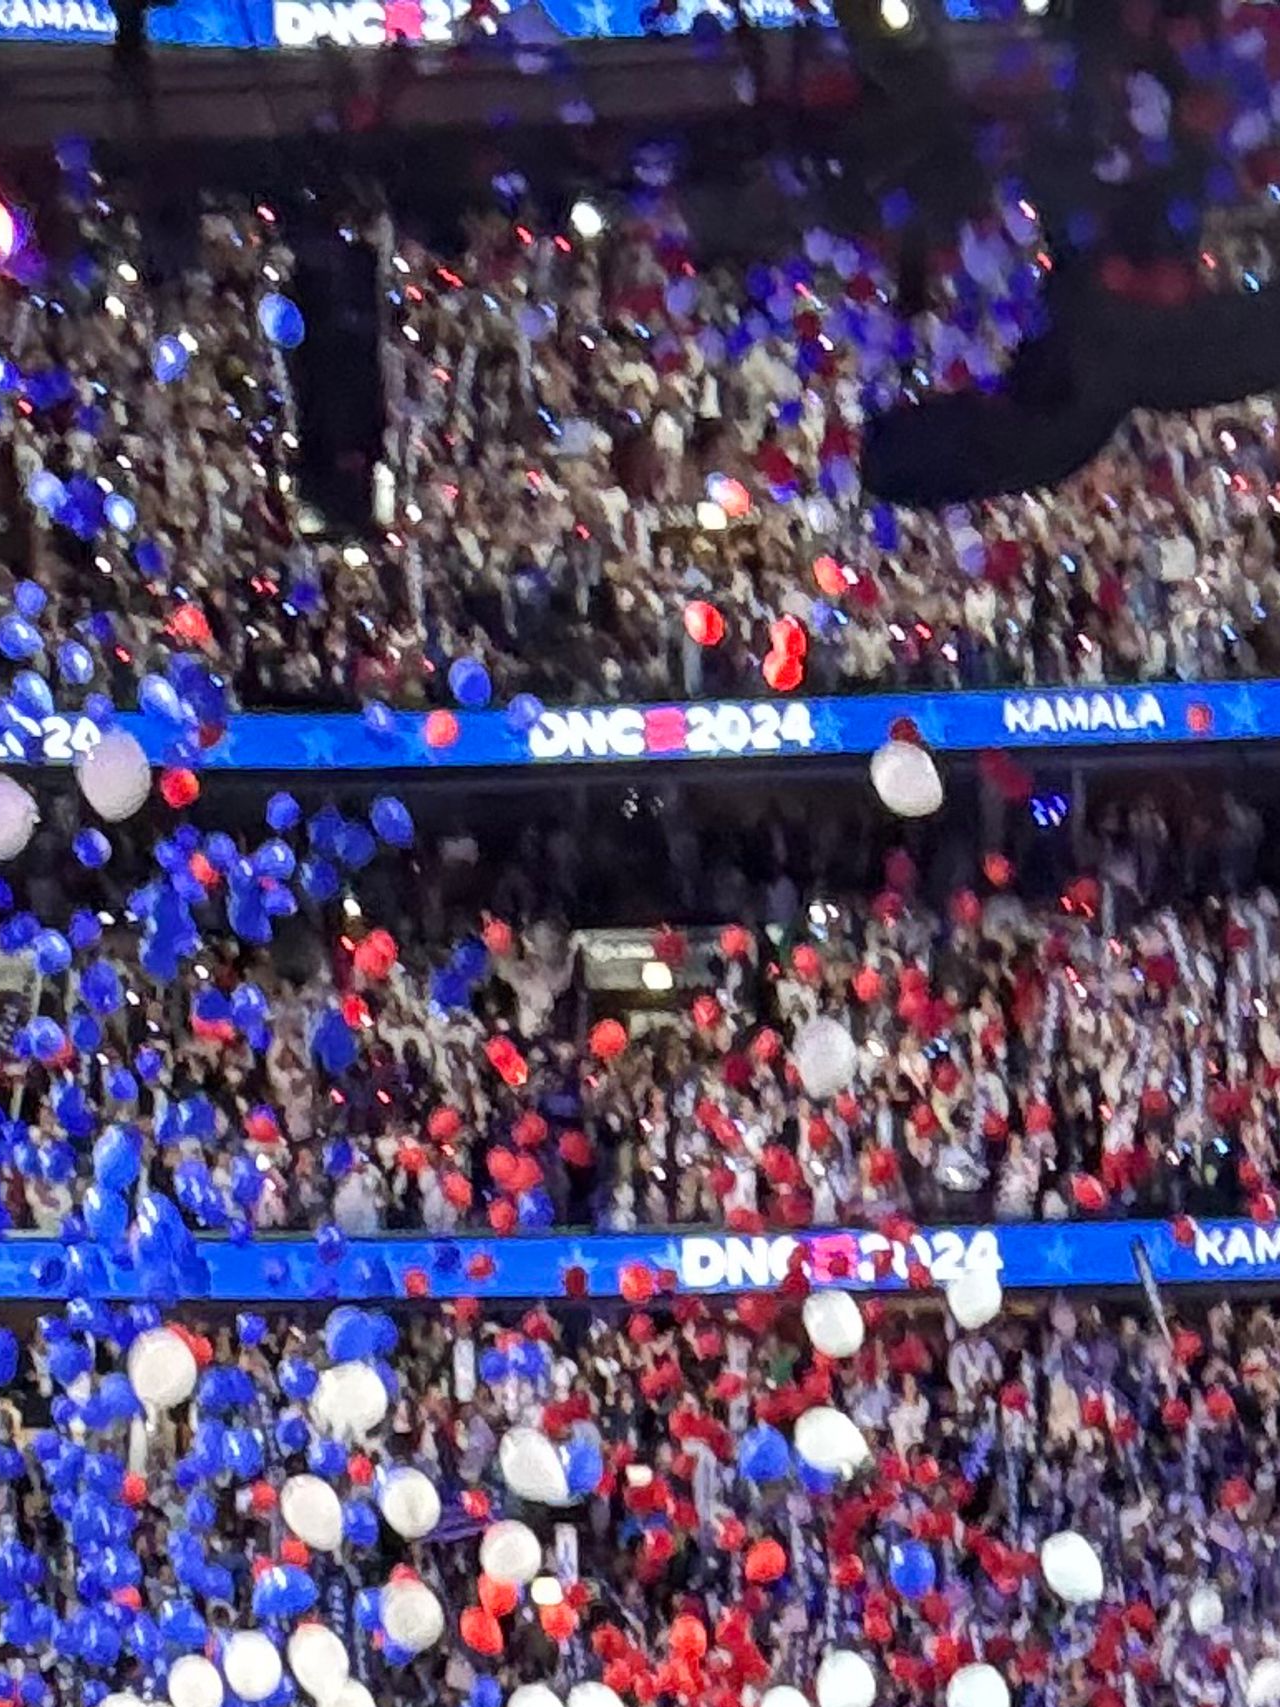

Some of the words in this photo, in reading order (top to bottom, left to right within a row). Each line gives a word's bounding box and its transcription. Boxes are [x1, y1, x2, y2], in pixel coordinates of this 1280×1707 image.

[528, 706, 646, 757] DNC
[684, 702, 816, 753] 2024
[1003, 694, 1166, 733] KAMALA
